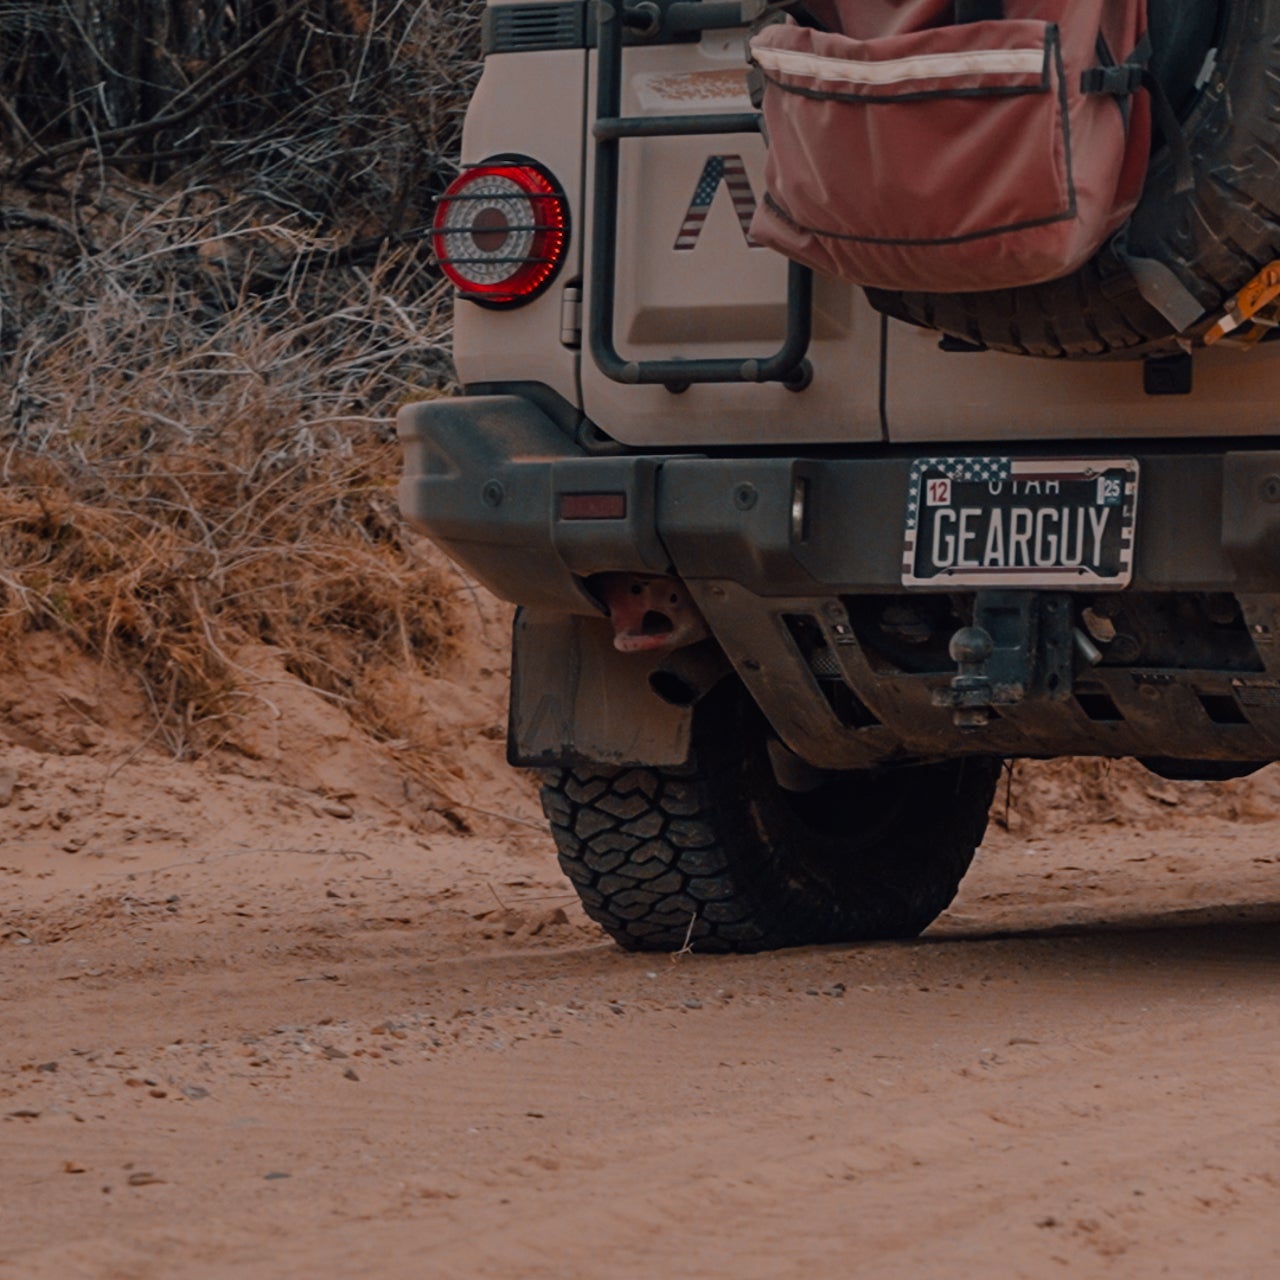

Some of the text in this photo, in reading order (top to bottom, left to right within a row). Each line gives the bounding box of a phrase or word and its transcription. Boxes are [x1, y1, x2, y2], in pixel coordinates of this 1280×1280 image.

[929, 481, 948, 503] 12
[1104, 479, 1121, 497] 25
[931, 507, 1111, 567] GEARGUY
